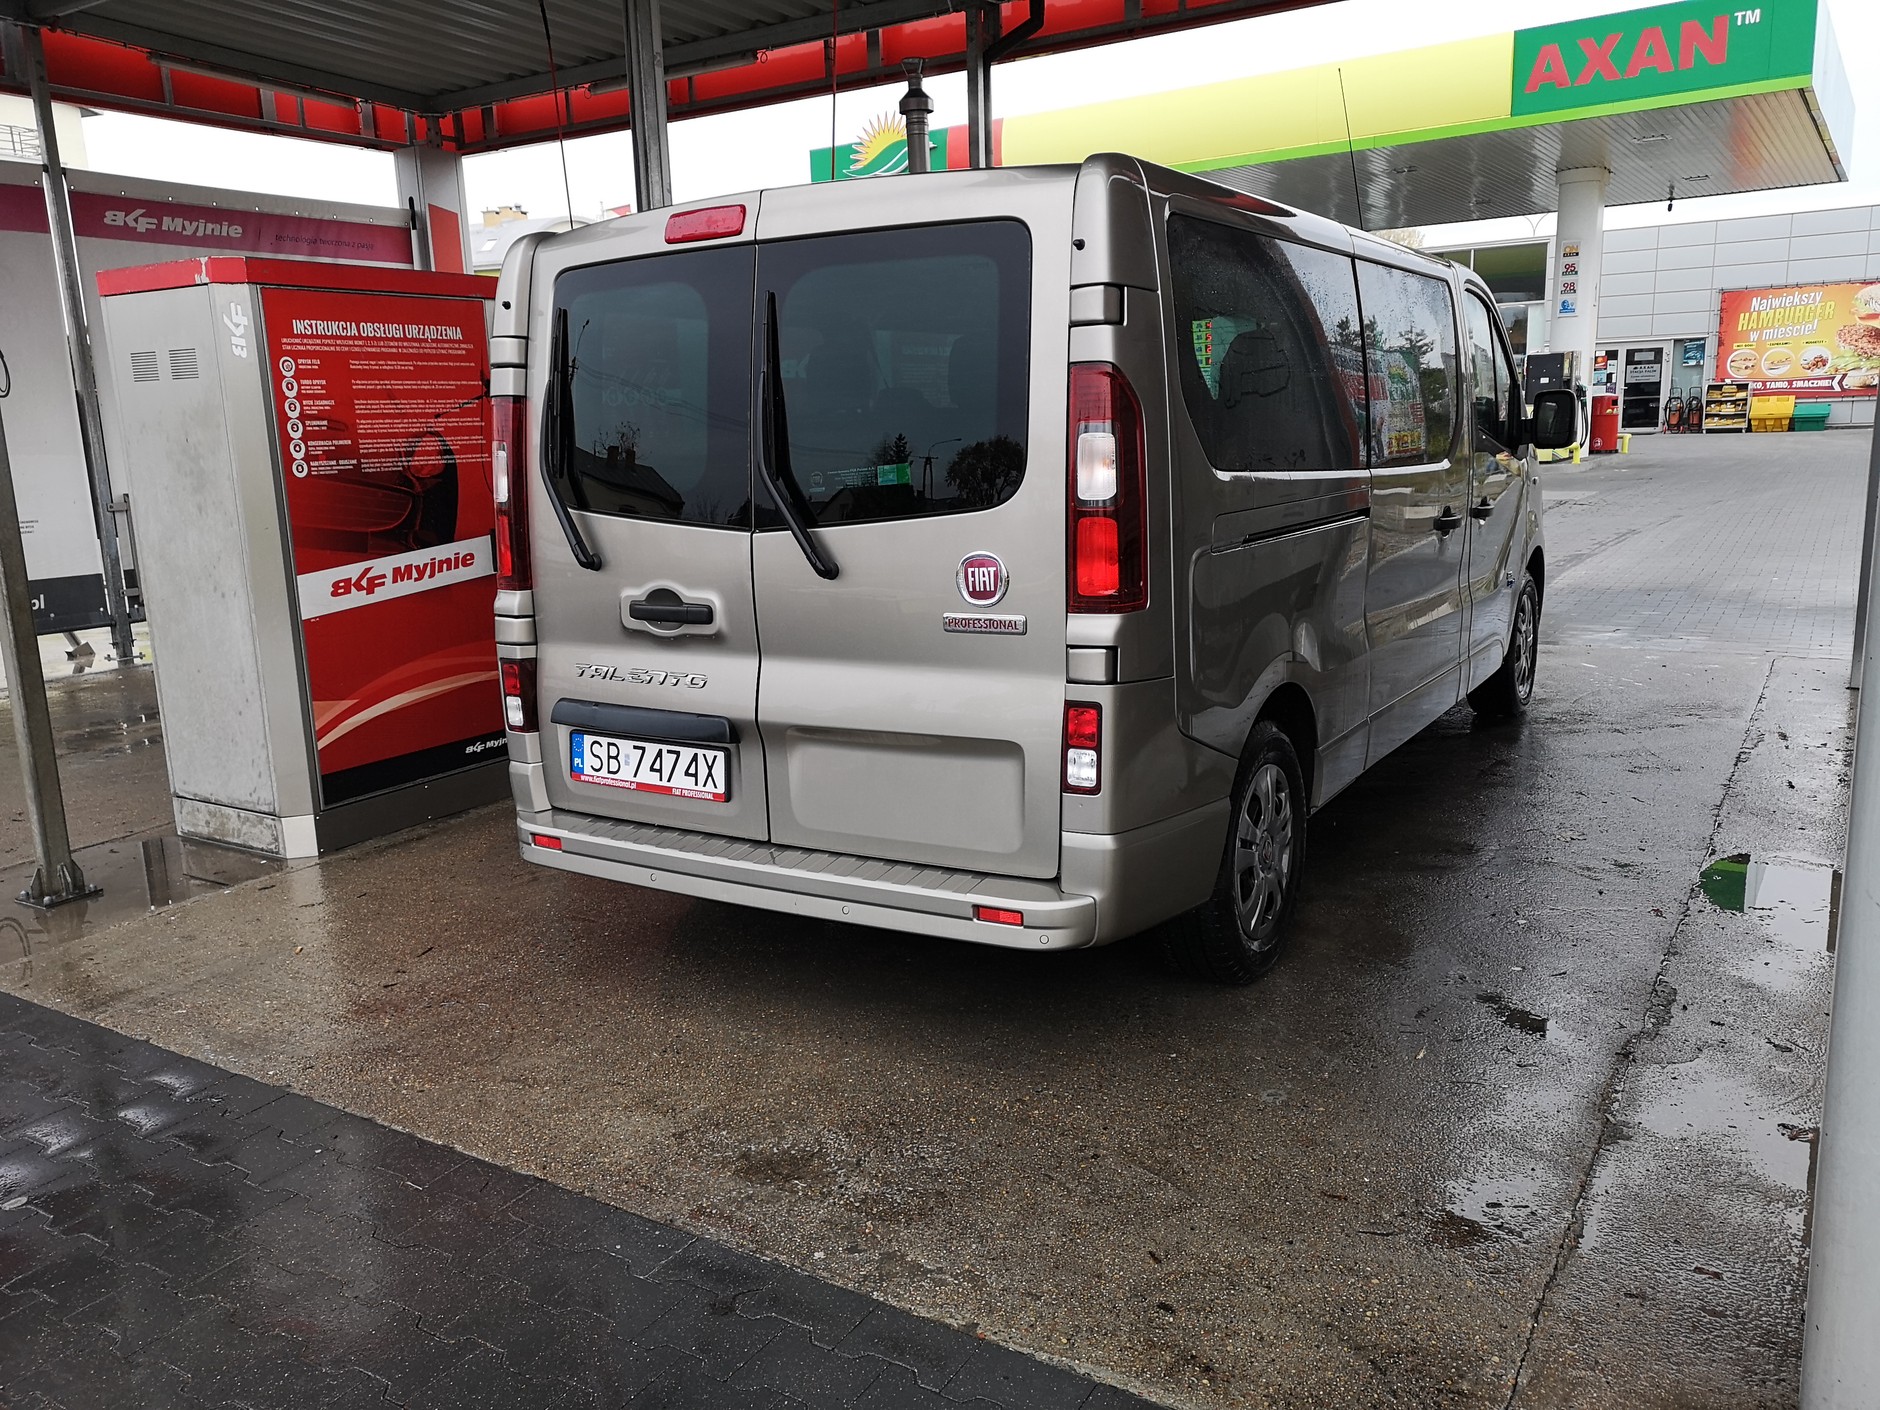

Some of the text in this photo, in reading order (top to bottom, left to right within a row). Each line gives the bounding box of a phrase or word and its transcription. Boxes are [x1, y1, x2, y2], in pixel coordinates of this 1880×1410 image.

[1524, 14, 1730, 94] AXAN
[103, 208, 243, 237] BKF Myjnie
[275, 234, 318, 245] technologia
[1564, 263, 1576, 272] 95
[1562, 282, 1576, 291] 98
[1738, 301, 1836, 331] HAMBURGER
[292, 319, 463, 342] INSTRUKCJA OBSŁUGI URZĄDZENIA
[1750, 319, 1818, 341] w mieście!
[330, 552, 476, 597] BKF Myjnie
[967, 567, 997, 592] FIAT
[947, 617, 1020, 631] PROFESSIONAL
[575, 662, 709, 689] TALENTO
[486, 737, 508, 748] Myjn
[574, 758, 583, 768] PL
[590, 740, 621, 775] SB
[632, 745, 718, 789] 7474X
[580, 774, 637, 789] www.fiatprofessional.pl
[672, 788, 714, 800] FIAT PROFESSIONAL
